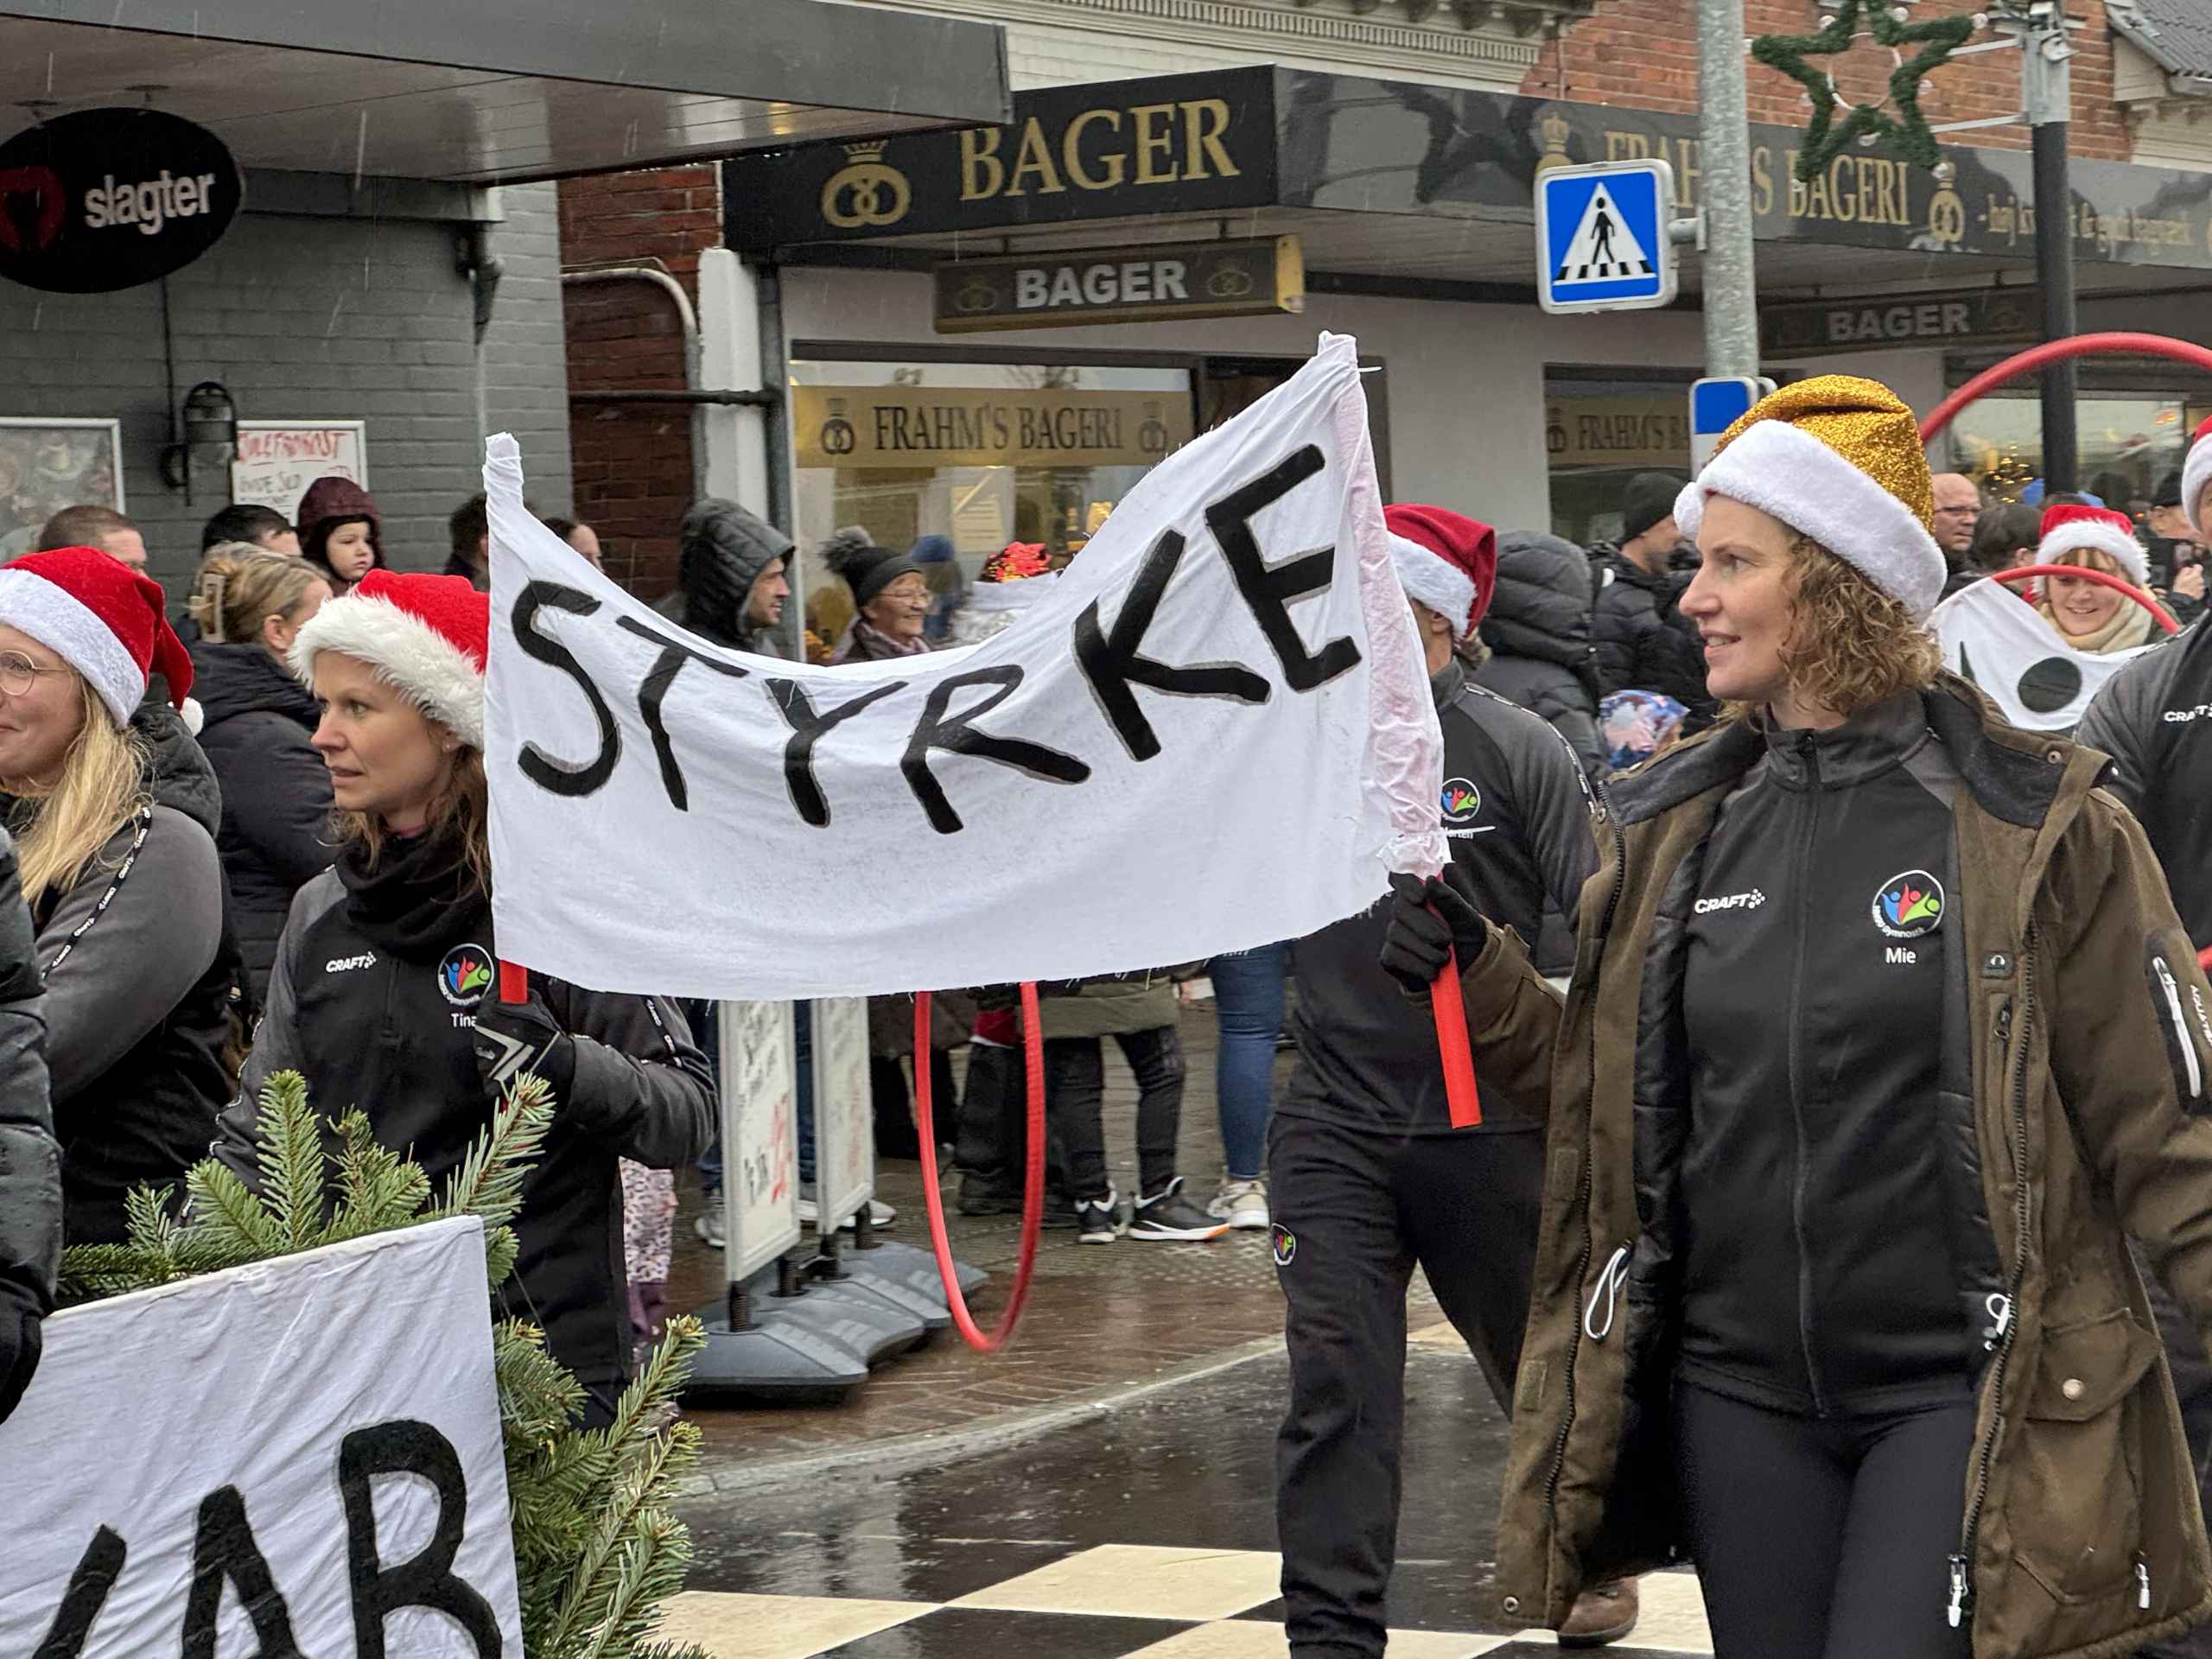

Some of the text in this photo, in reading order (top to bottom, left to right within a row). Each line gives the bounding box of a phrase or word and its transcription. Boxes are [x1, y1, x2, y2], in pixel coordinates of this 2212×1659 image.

[959, 99, 1241, 200] BAGER
[85, 169, 215, 235] slagter
[1015, 260, 1190, 308] BAGER
[1827, 303, 1971, 341] BAGER
[872, 403, 1123, 450] FRAHM'S BAGERI
[511, 442, 1363, 836] STYRKE
[1694, 893, 1751, 914] CRAFT
[326, 956, 366, 973] CRAFT
[1885, 947, 1916, 964] Mie
